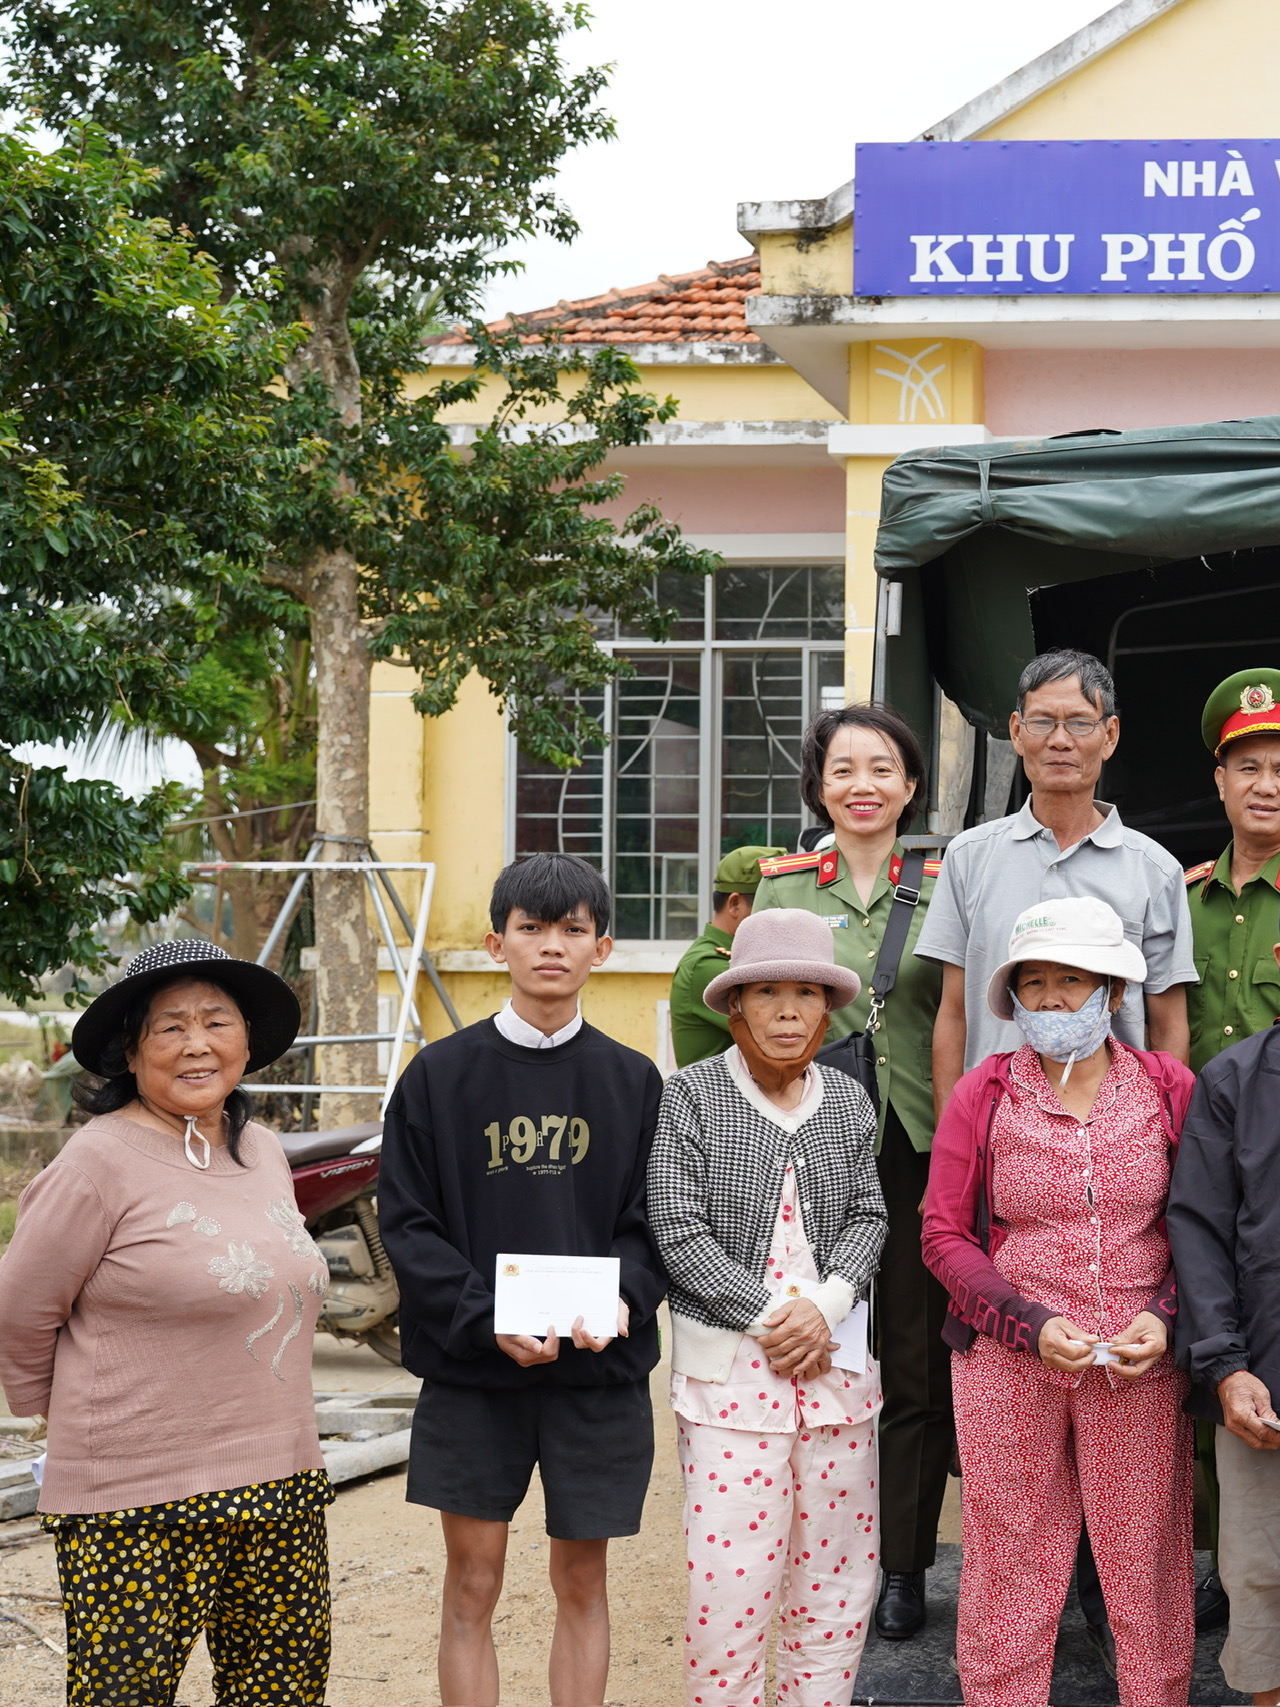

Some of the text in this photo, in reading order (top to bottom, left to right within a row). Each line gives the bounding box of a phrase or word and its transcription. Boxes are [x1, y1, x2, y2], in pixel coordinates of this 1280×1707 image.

[1144, 149, 1255, 198] NHÀ
[909, 234, 1075, 284] KHU
[1100, 207, 1261, 283] PHỐ
